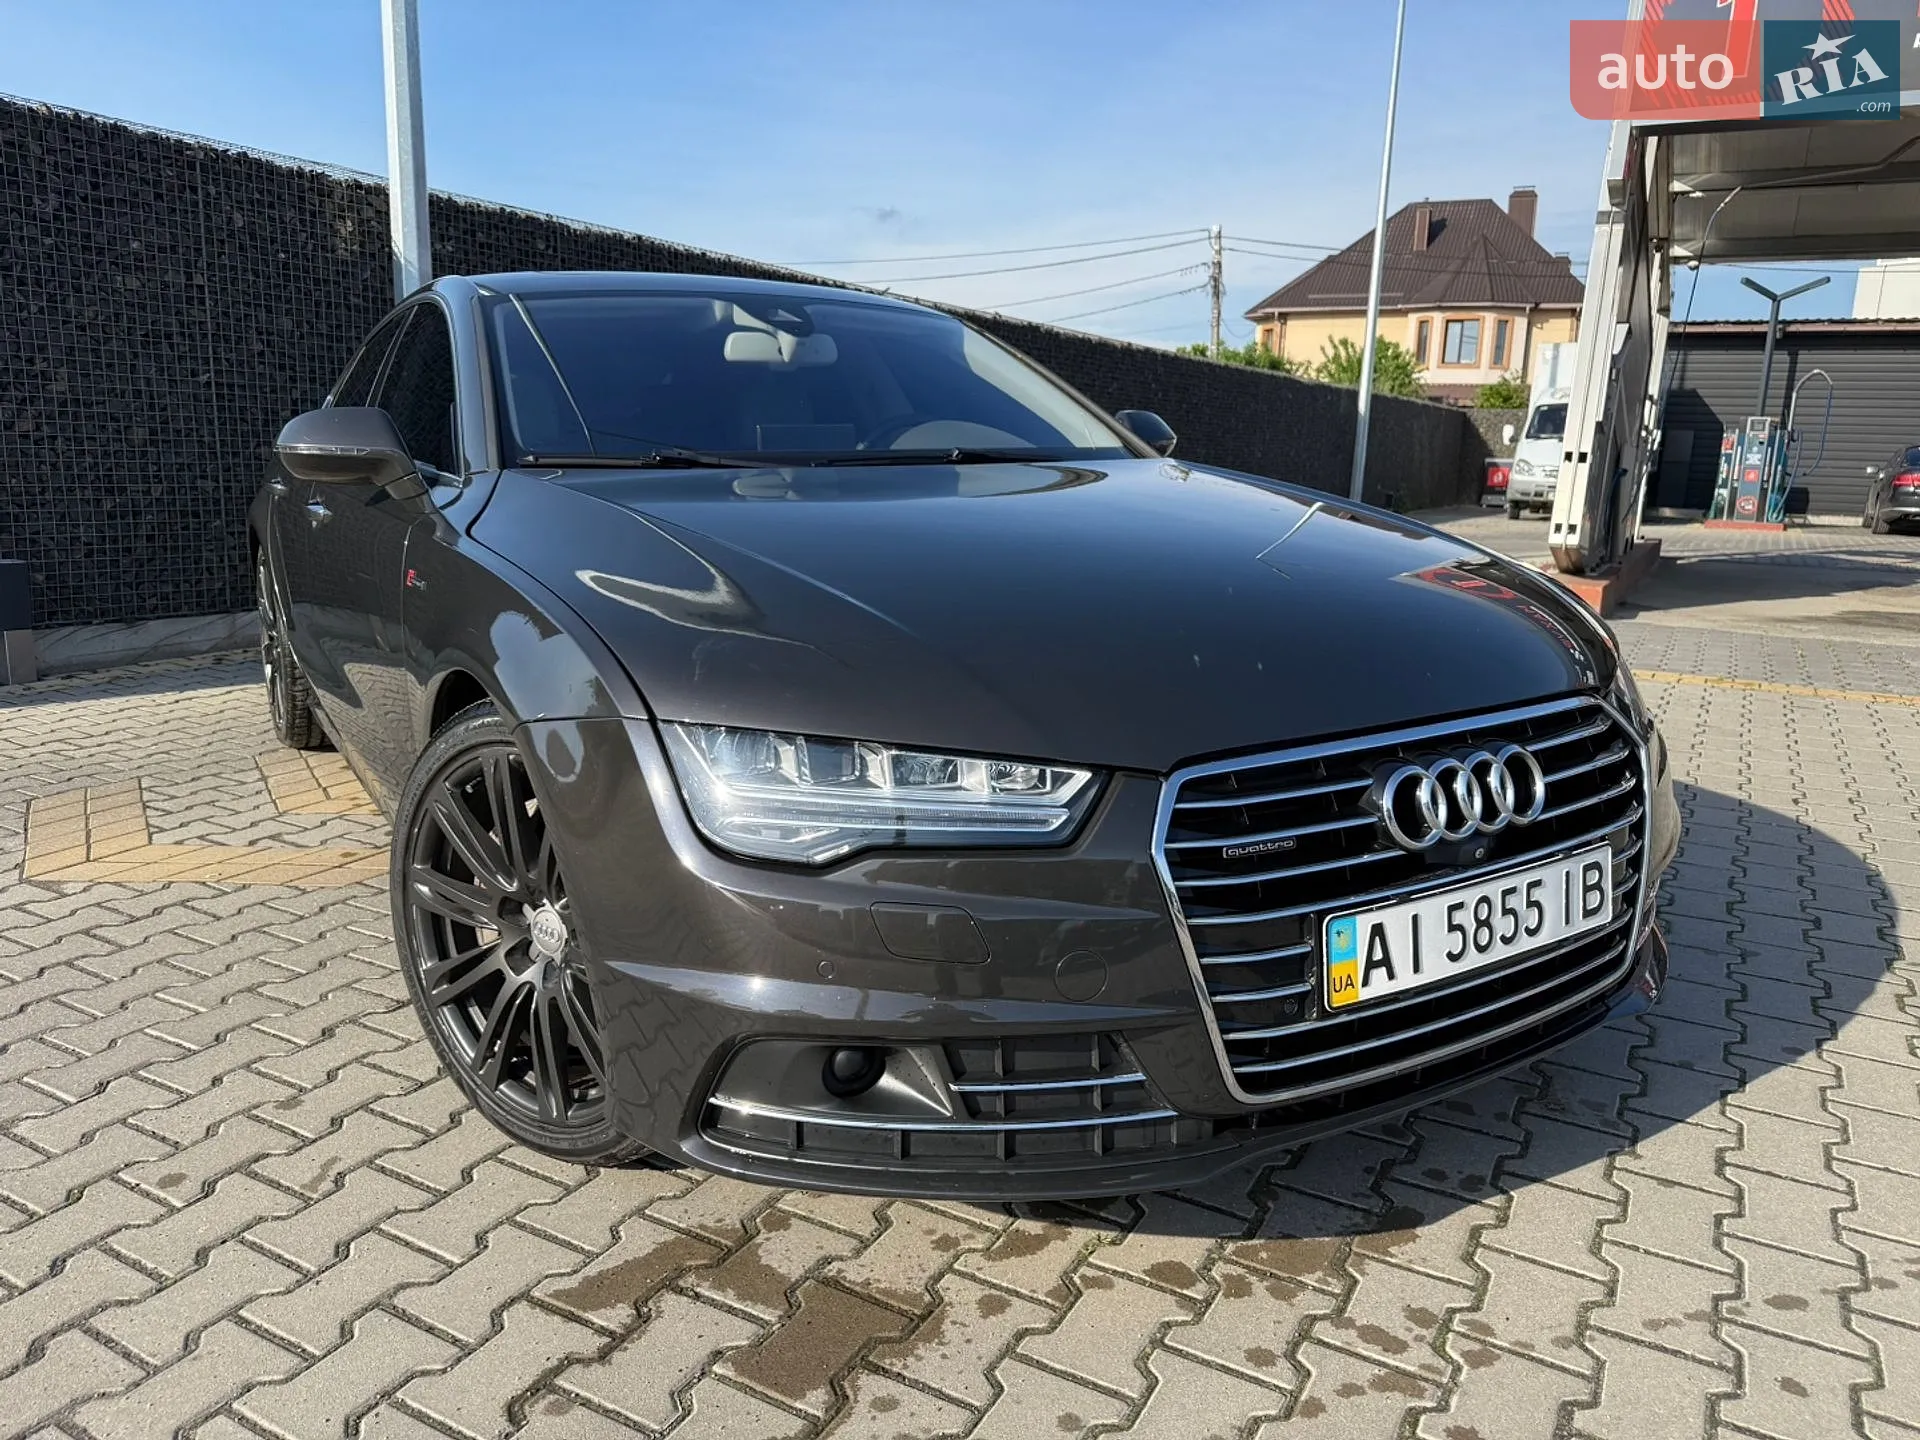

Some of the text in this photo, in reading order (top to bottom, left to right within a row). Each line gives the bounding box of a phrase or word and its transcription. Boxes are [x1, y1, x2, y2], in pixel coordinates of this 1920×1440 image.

[1227, 840, 1294, 856] quattro
[1361, 860, 1605, 988] AI 5855 IB
[1332, 974, 1356, 994] UA
